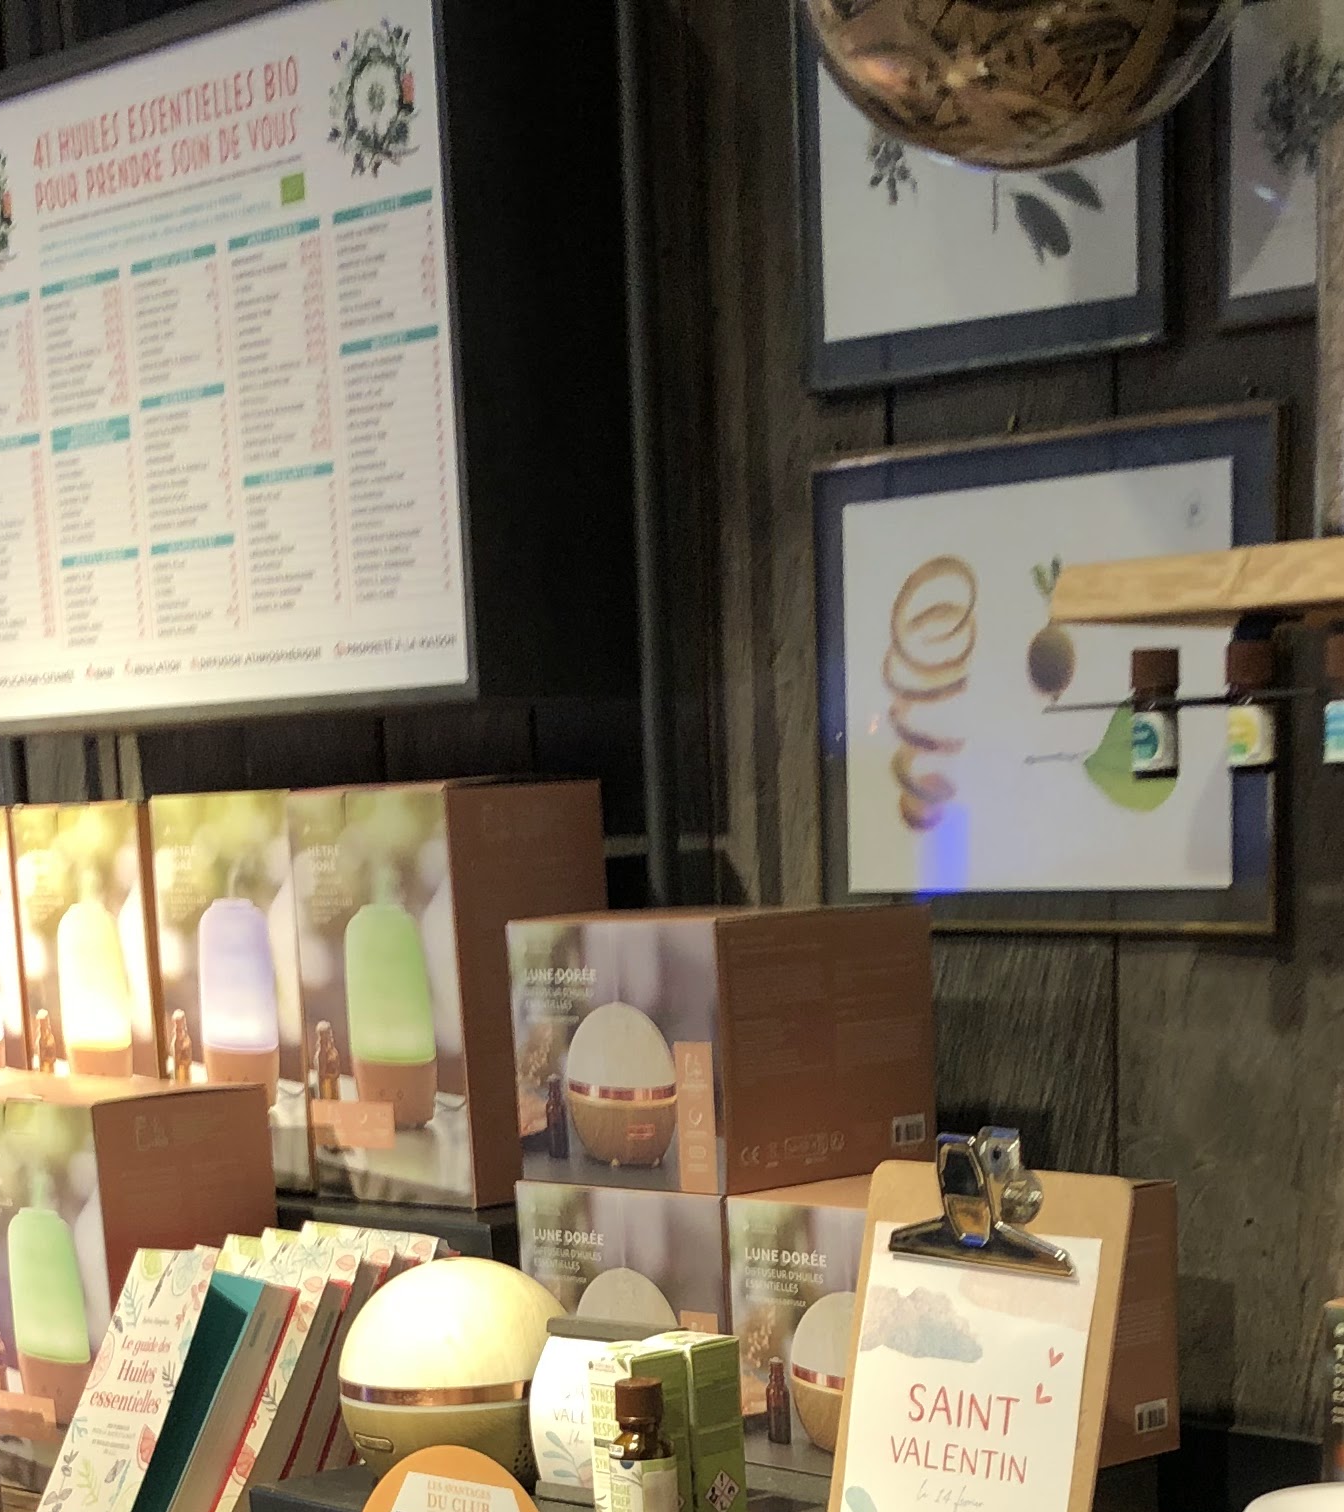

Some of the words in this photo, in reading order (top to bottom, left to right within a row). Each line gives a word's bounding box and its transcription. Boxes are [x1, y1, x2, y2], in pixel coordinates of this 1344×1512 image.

[59, 113, 120, 164] HUILES
[129, 78, 254, 141] ESSENTIELLES
[265, 56, 299, 100] BIO
[35, 172, 79, 213] POUR
[86, 153, 162, 206] PRENDRE
[171, 138, 211, 177] SOIN
[219, 130, 241, 162] DE
[246, 109, 299, 154] VOUS
[524, 968, 553, 981] LUNE
[555, 965, 597, 982] DORÉE
[533, 1228, 562, 1242] LUNE
[565, 1229, 604, 1246] DORÉE
[534, 1247, 568, 1259] DIFFUSEUR
[570, 1249, 602, 1262] D'HUILES
[744, 1247, 778, 1262] LUNE
[780, 1250, 827, 1267] DORÉE
[534, 1259, 580, 1272] ESSENTIELLES
[745, 1267, 787, 1280] DIFFUSEUR
[788, 1270, 824, 1283] D'HUILES
[745, 1280, 799, 1294] ESSENTIELLES
[121, 1334, 133, 1349] Le
[133, 1336, 157, 1355] guide
[157, 1336, 171, 1353] des
[117, 1358, 157, 1384] Huiles
[89, 1388, 162, 1415] essentielles
[907, 1382, 1020, 1437] SAINT
[890, 1434, 1028, 1485] VALENTIN
[427, 1480, 442, 1491] LES
[445, 1483, 491, 1500] AVANTAGES
[935, 1488, 953, 1504] 14
[427, 1492, 447, 1510] DU
